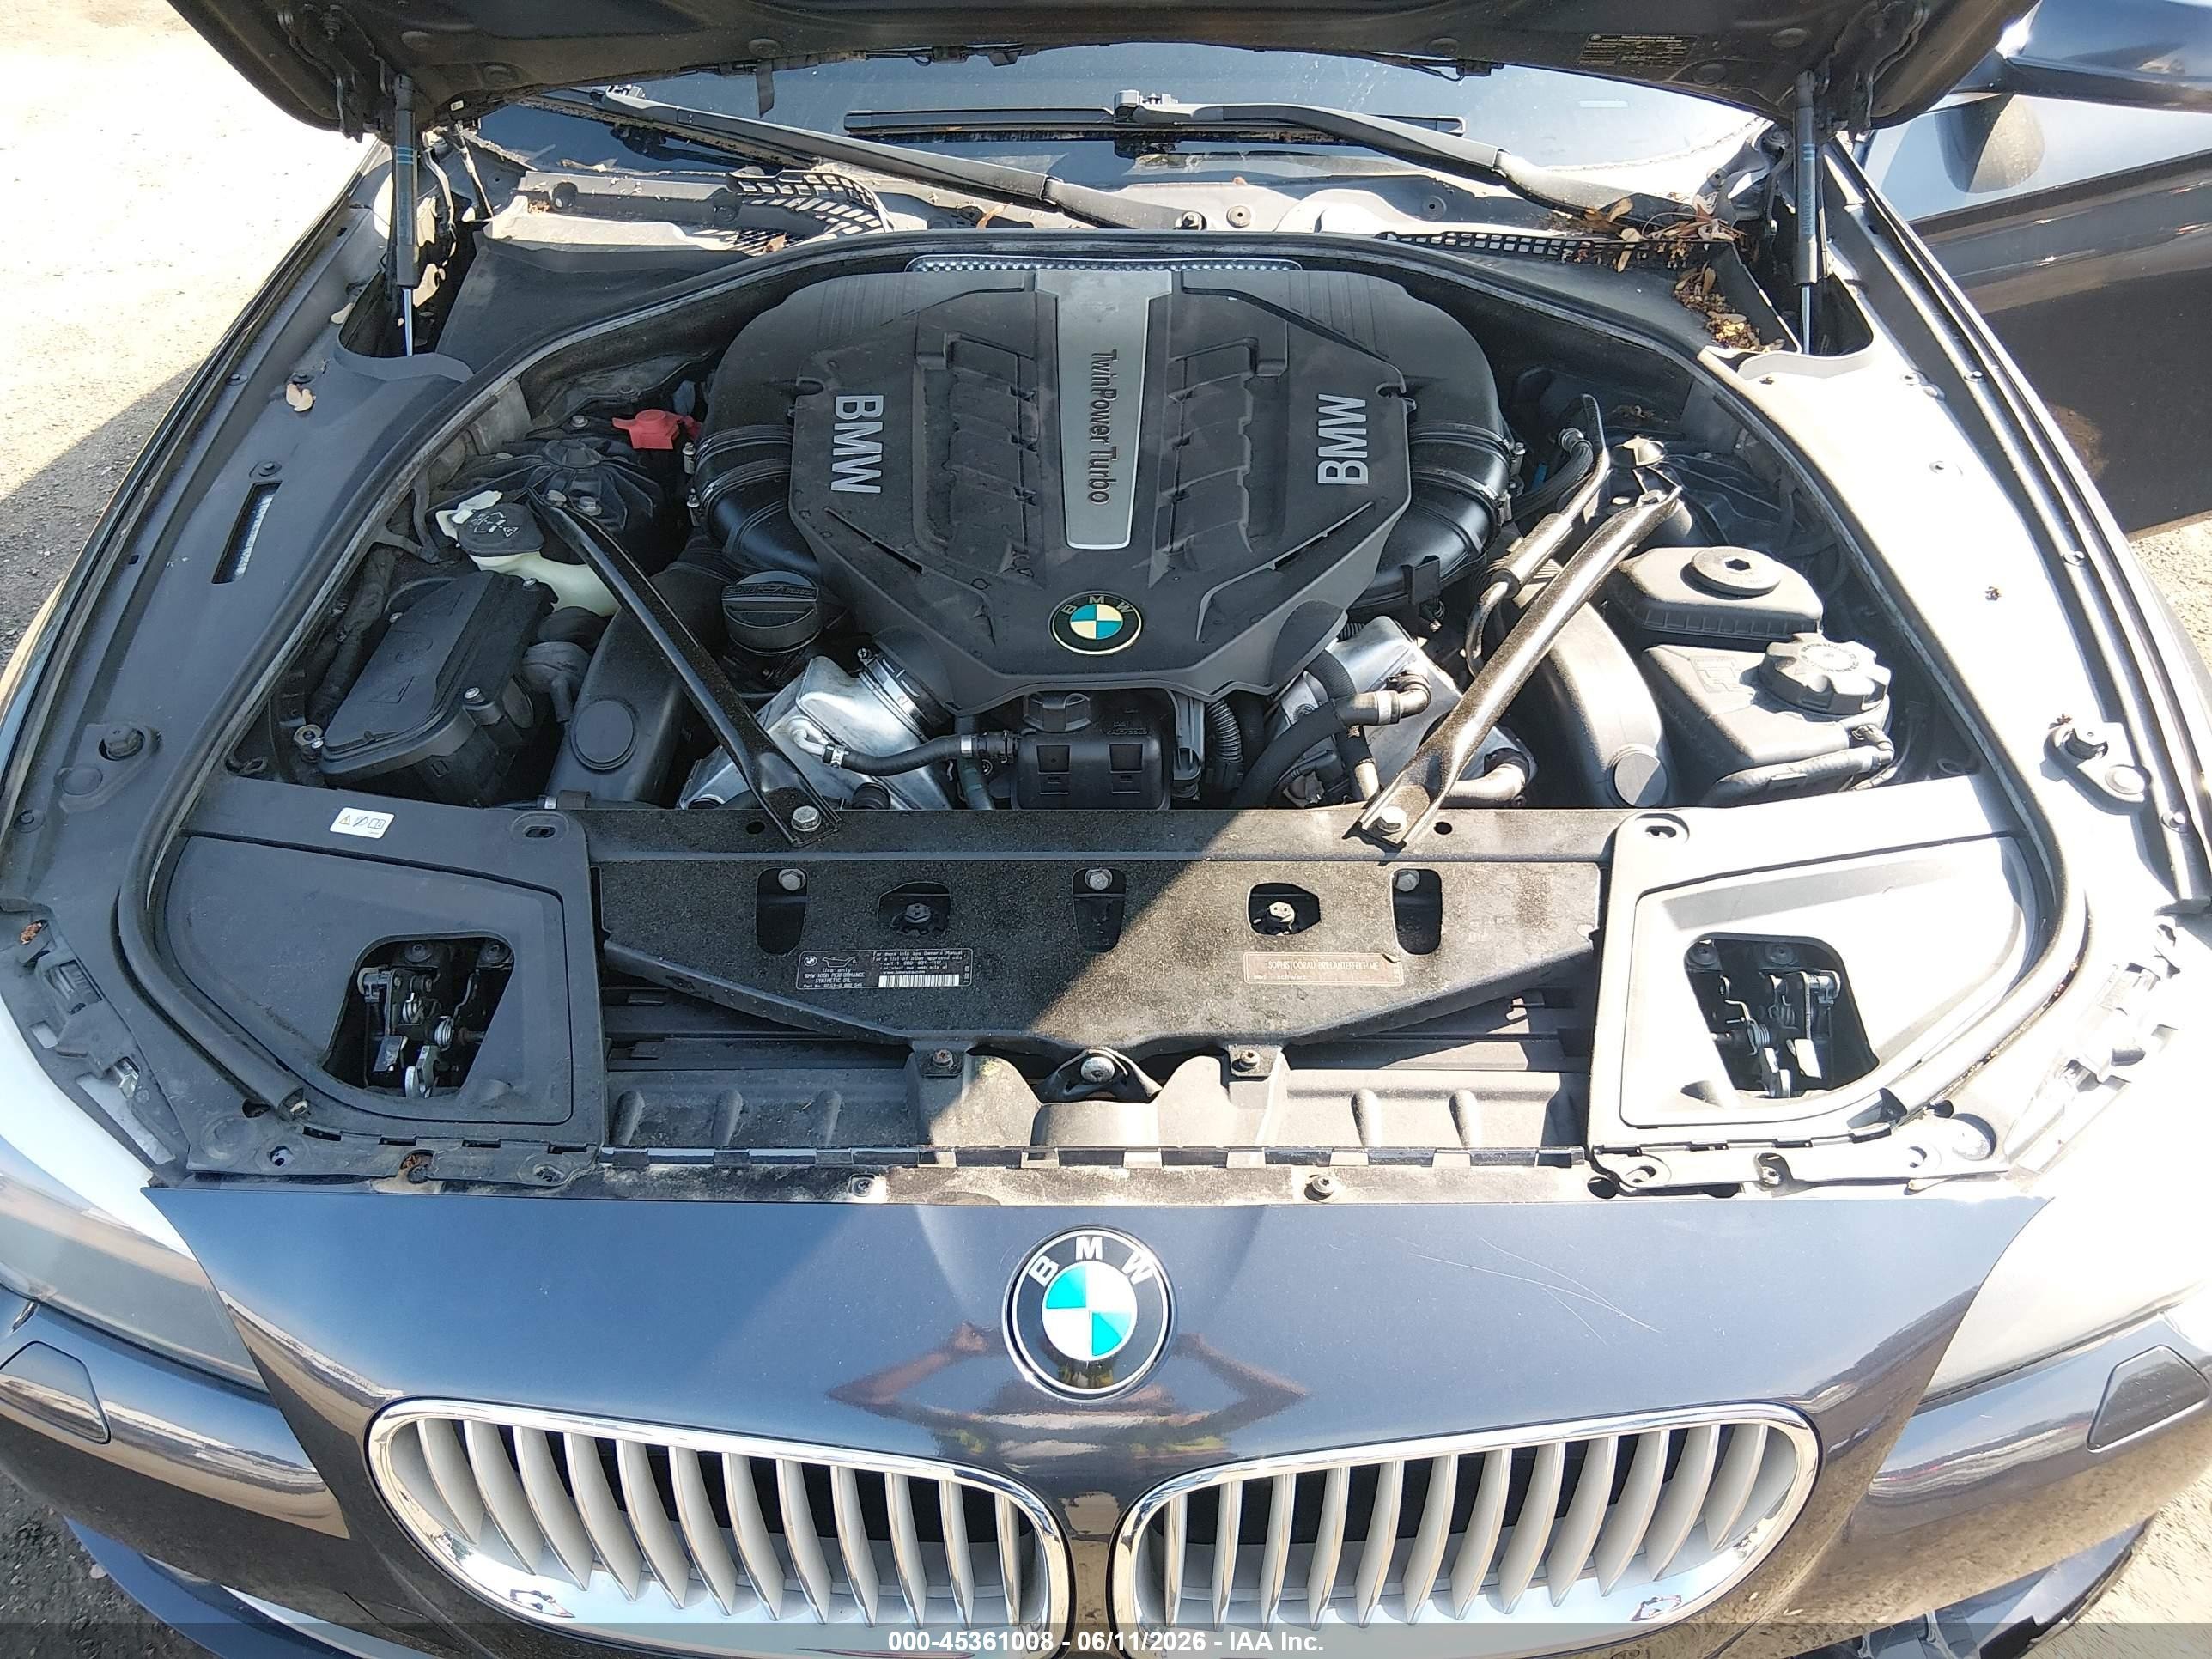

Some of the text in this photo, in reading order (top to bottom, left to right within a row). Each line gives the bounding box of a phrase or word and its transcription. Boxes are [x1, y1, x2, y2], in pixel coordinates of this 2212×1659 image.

[830, 394, 884, 494] BMW
[1086, 349, 1119, 505] TwinPower Turbo
[1317, 392, 1368, 485] BMW
[1060, 595, 1134, 615] BMW
[1027, 1236, 1155, 1288] BMW
